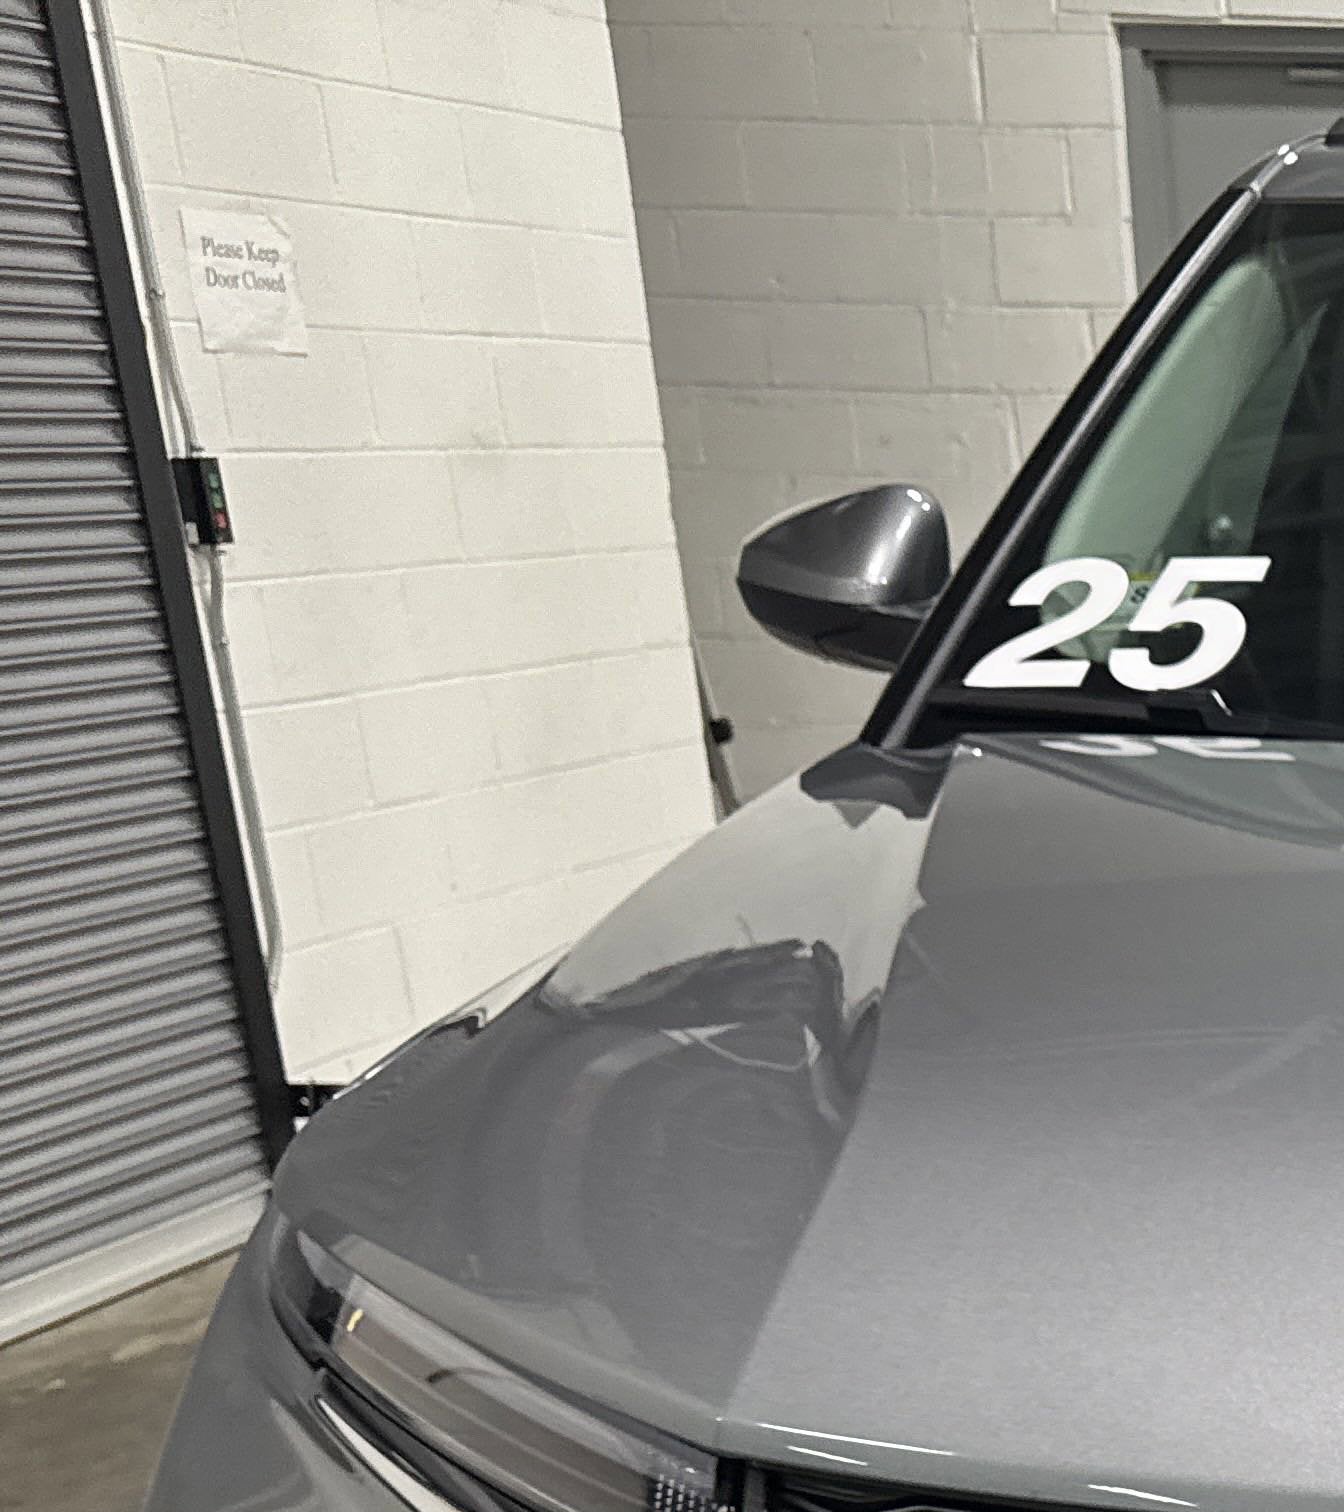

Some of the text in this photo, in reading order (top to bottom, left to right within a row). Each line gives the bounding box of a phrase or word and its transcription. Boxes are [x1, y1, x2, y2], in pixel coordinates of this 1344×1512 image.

[201, 236, 280, 268] Please Keep
[205, 266, 287, 293] Door Closed
[962, 555, 1272, 692] 25
